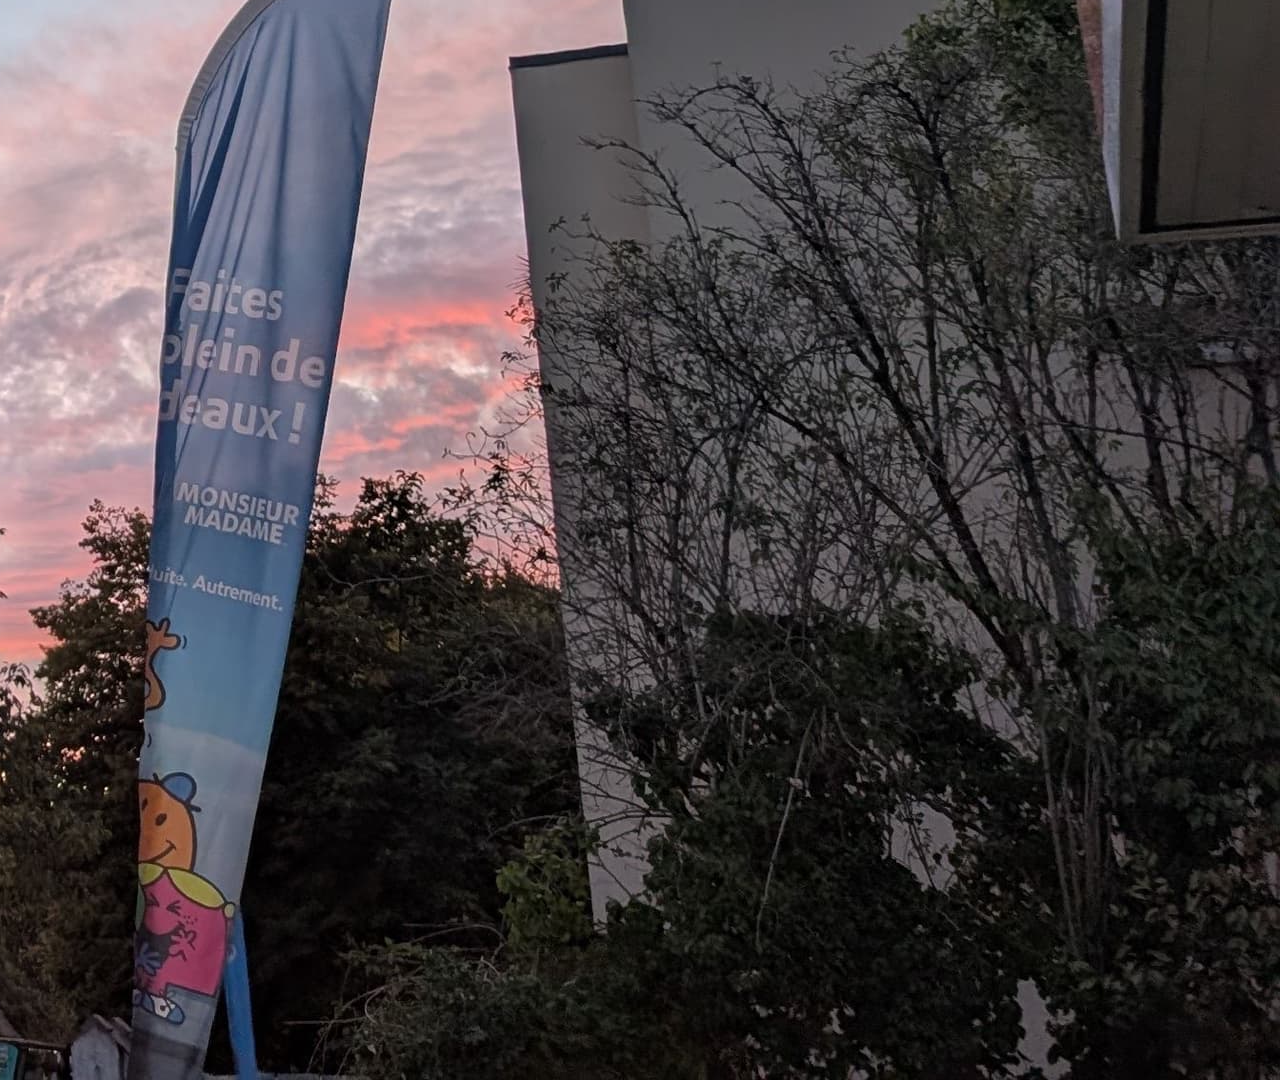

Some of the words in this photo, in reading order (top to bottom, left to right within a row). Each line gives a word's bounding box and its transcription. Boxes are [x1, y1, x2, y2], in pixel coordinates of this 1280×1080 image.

[167, 268, 284, 320] Faites
[271, 338, 326, 388] de
[176, 482, 300, 526] MONSIEUR
[184, 505, 284, 544] MADAME
[149, 565, 188, 587] uite.
[192, 575, 283, 612] Autrement.
